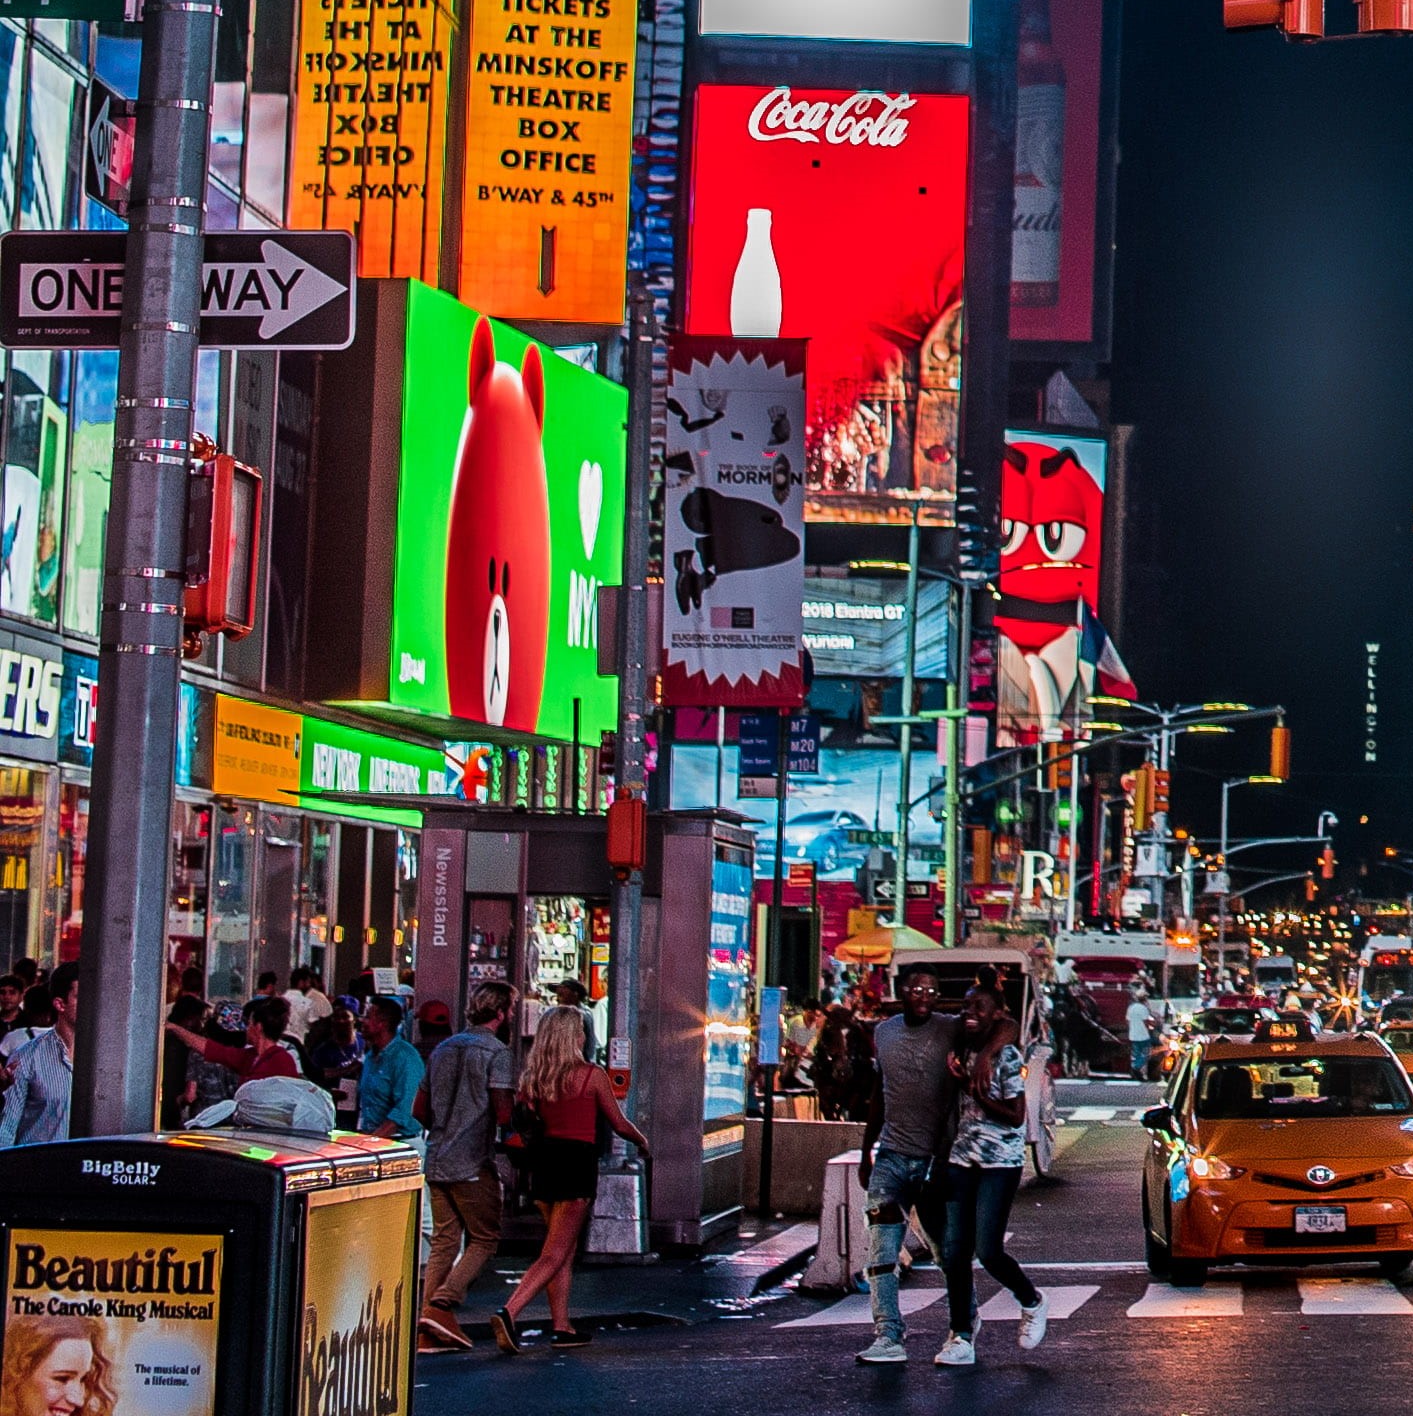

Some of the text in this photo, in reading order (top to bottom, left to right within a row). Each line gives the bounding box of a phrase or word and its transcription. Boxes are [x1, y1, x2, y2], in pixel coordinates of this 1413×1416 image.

[505, 24, 602, 50] AT THE
[476, 52, 629, 83] MINSKOFF
[490, 84, 612, 113] THEATRE
[518, 117, 582, 143] BOX
[499, 148, 597, 175] OFFICE
[477, 184, 615, 208] B'WAY & 45TH
[30, 268, 304, 312] ONE WAY
[717, 470, 804, 486] MORMON
[567, 568, 603, 650] NY
[671, 633, 796, 643] EUGENE O'NEILL THEATRE
[791, 719, 808, 733] M7
[790, 739, 815, 753] M20
[789, 759, 816, 772] M104
[432, 846, 453, 947] Newsstand
[81, 1159, 161, 1177] BigBelly
[14, 1242, 219, 1296] Beautiful
[12, 1295, 215, 1322] The Carole King Musical
[134, 1364, 201, 1375] The musical of
[150, 1375, 190, 1386] lifetime.
